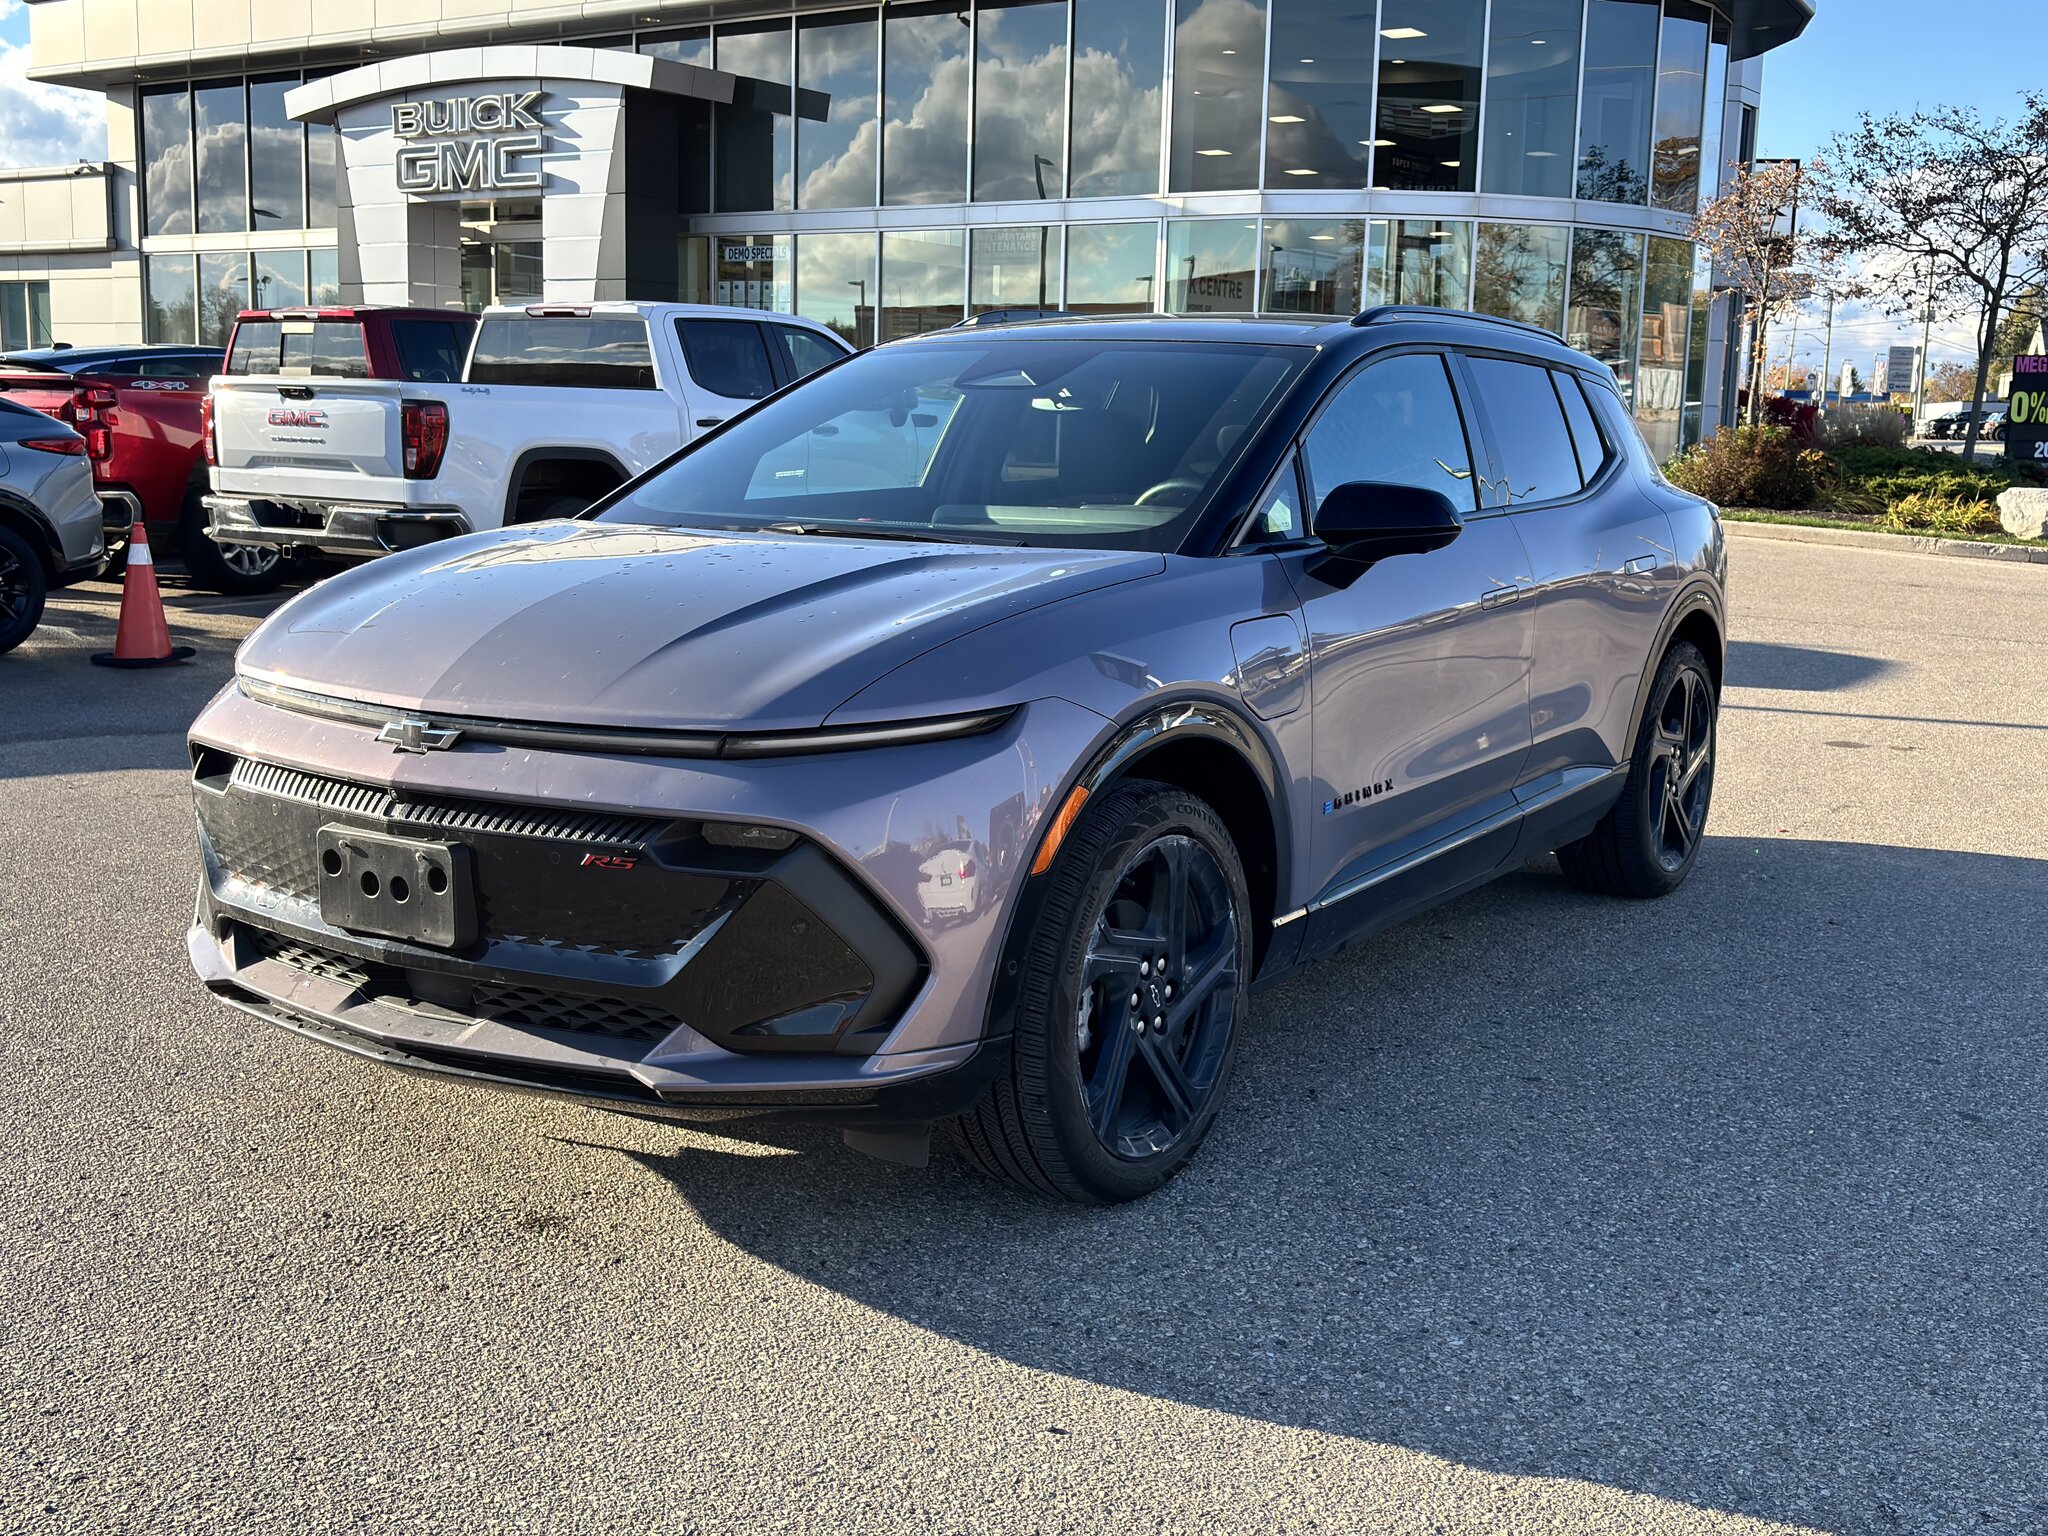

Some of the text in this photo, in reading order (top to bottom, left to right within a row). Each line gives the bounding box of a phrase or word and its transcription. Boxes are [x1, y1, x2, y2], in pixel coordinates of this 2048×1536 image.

[391, 91, 544, 138] BUICK
[396, 135, 542, 193] GMC
[728, 247, 787, 260] DEMO SPECIALS
[1199, 277, 1242, 299] CENTRE
[2015, 356, 2048, 373] MEG
[267, 409, 325, 428] GMC
[1323, 778, 1394, 815] EQUINOX
[580, 853, 638, 870] RS
